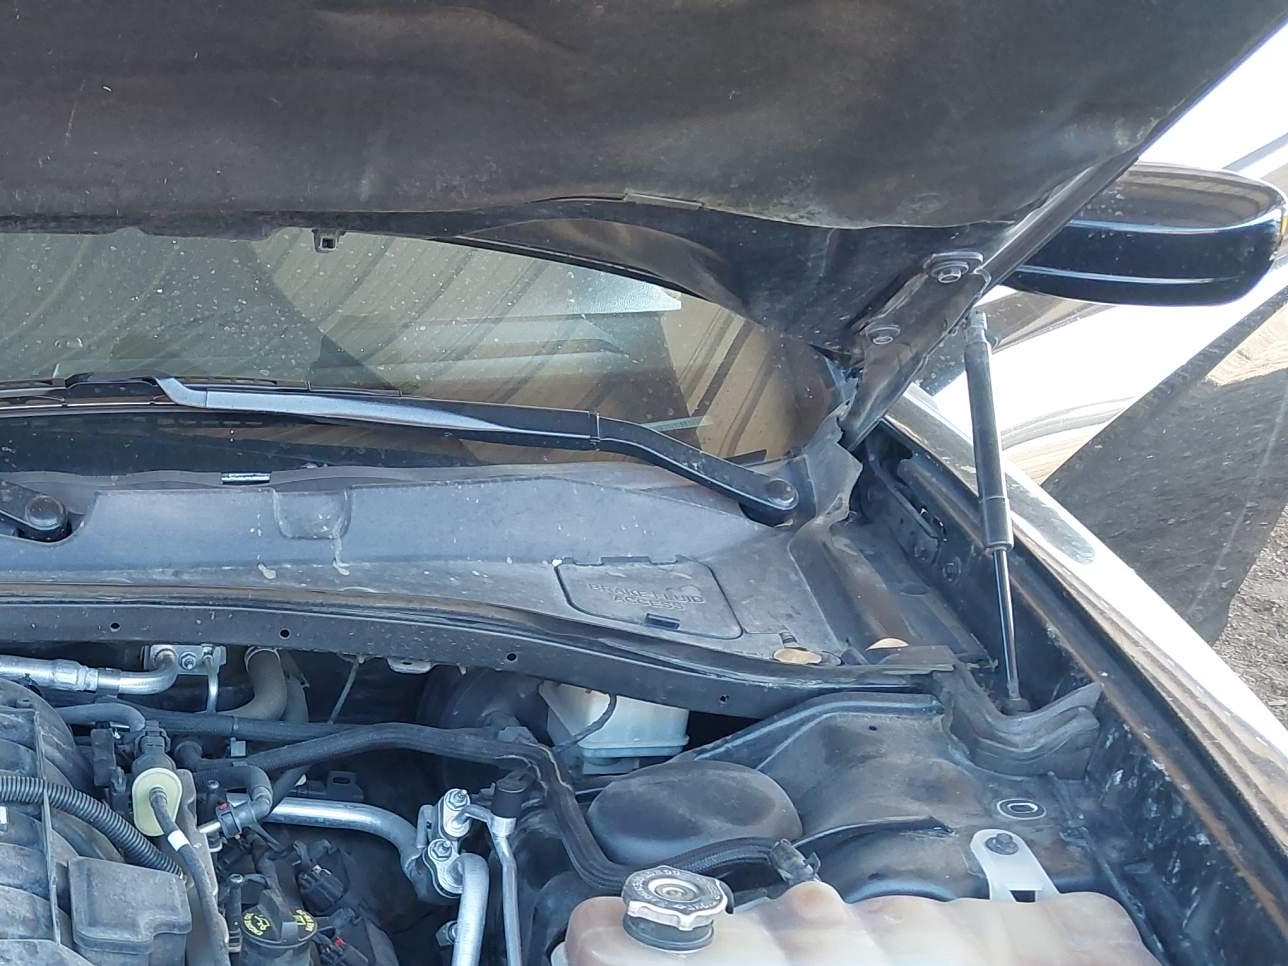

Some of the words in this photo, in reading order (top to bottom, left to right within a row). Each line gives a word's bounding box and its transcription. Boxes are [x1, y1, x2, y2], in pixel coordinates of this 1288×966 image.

[587, 583, 651, 598] BRAKE
[653, 590, 706, 604] FLUID
[611, 594, 684, 610] ACCESS
